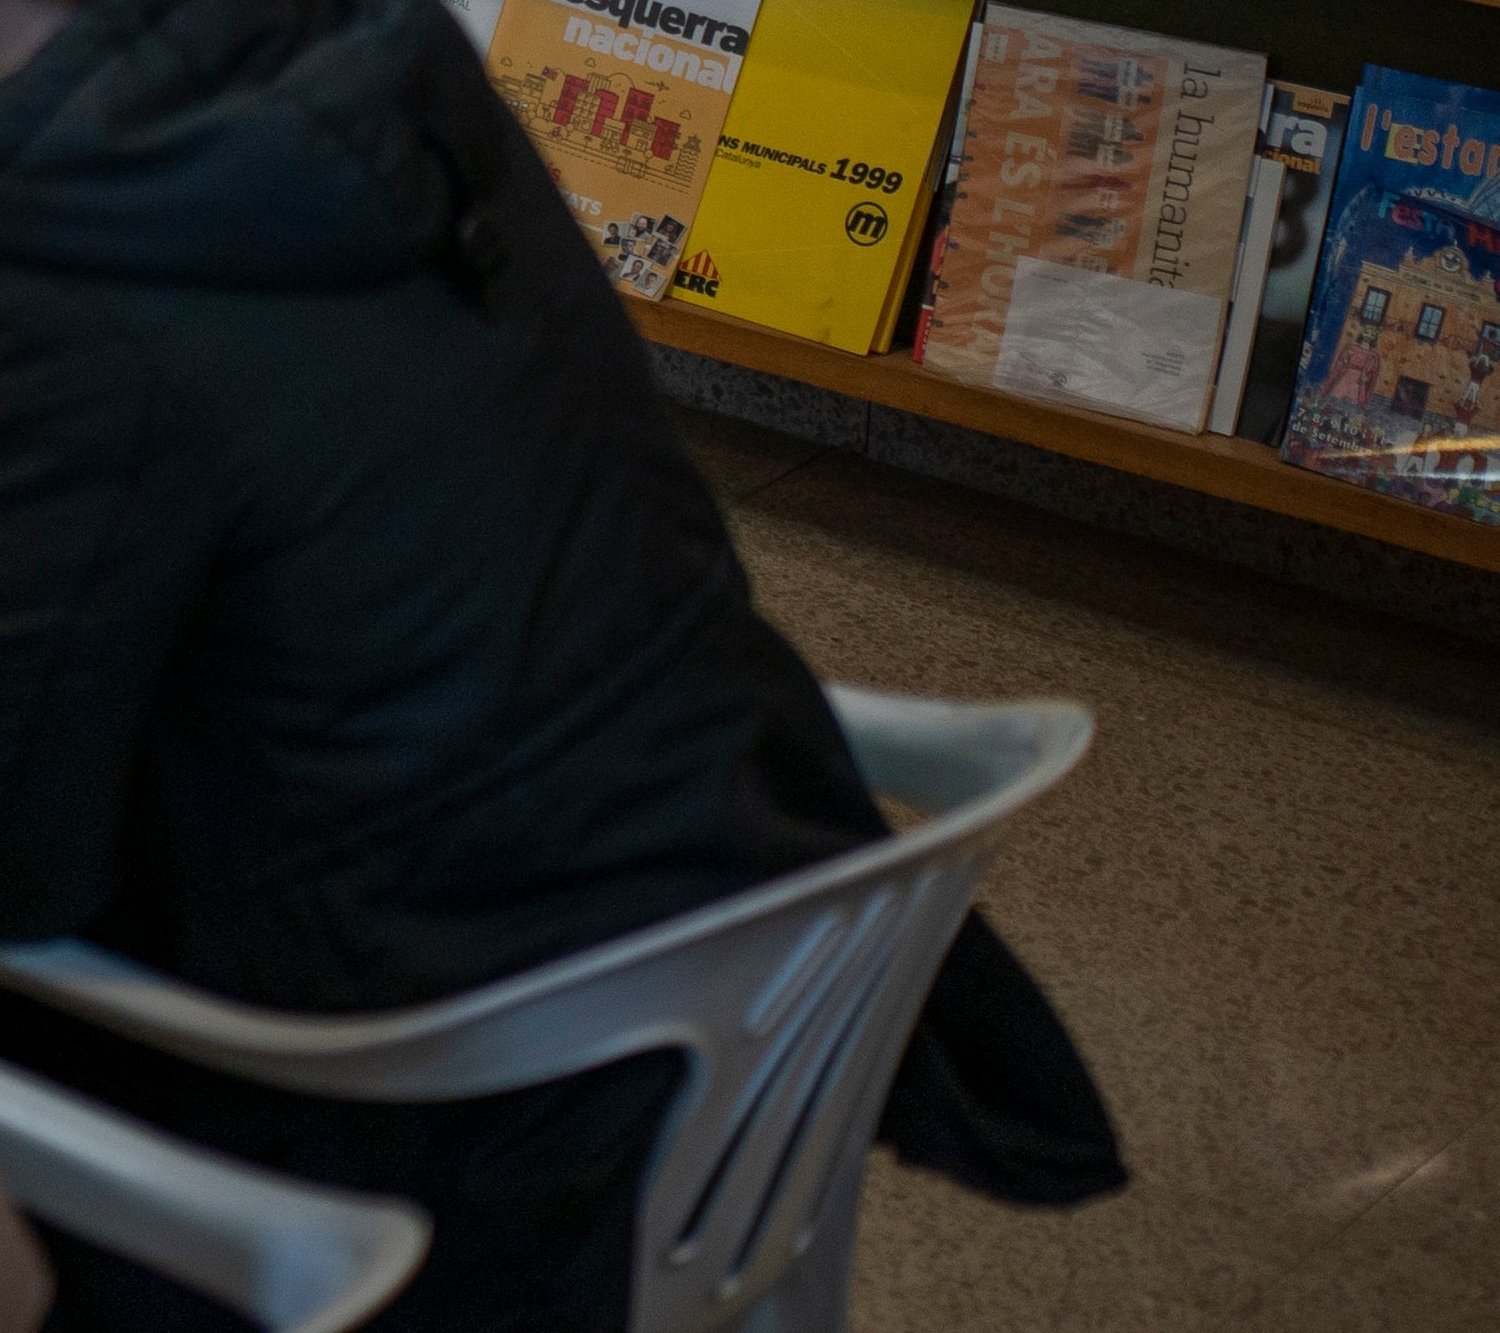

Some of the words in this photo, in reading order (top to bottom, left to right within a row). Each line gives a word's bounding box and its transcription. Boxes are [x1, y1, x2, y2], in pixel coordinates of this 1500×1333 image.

[563, 15, 742, 93] nacional
[1008, 31, 1065, 121] ARA
[1179, 62, 1221, 101] la
[741, 142, 827, 175] MUNICIPALS
[830, 158, 903, 194] 1999
[1000, 131, 1058, 190] ÉS
[674, 270, 720, 298] ERC
